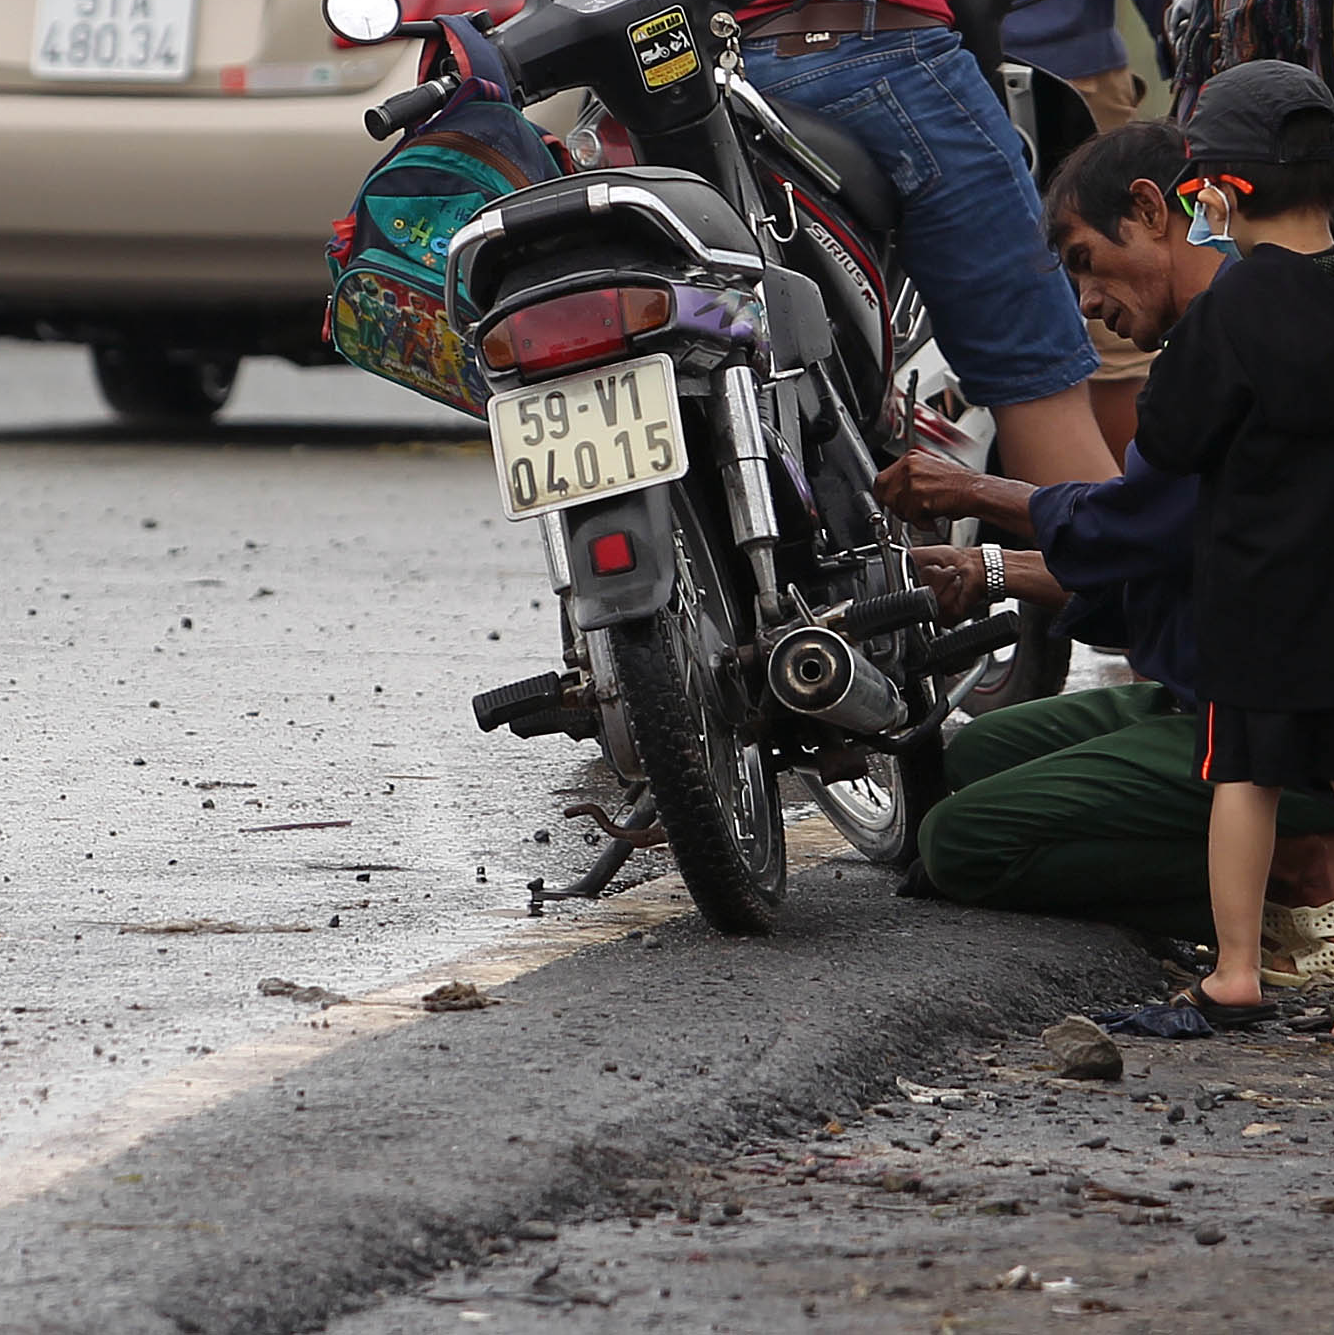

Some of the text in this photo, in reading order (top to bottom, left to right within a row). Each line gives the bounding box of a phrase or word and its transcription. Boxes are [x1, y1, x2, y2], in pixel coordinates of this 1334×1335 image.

[40, 20, 178, 65] 480.34
[804, 222, 867, 288] SIRIUS
[518, 370, 642, 447] 59-V1
[511, 420, 673, 507] 040.15
